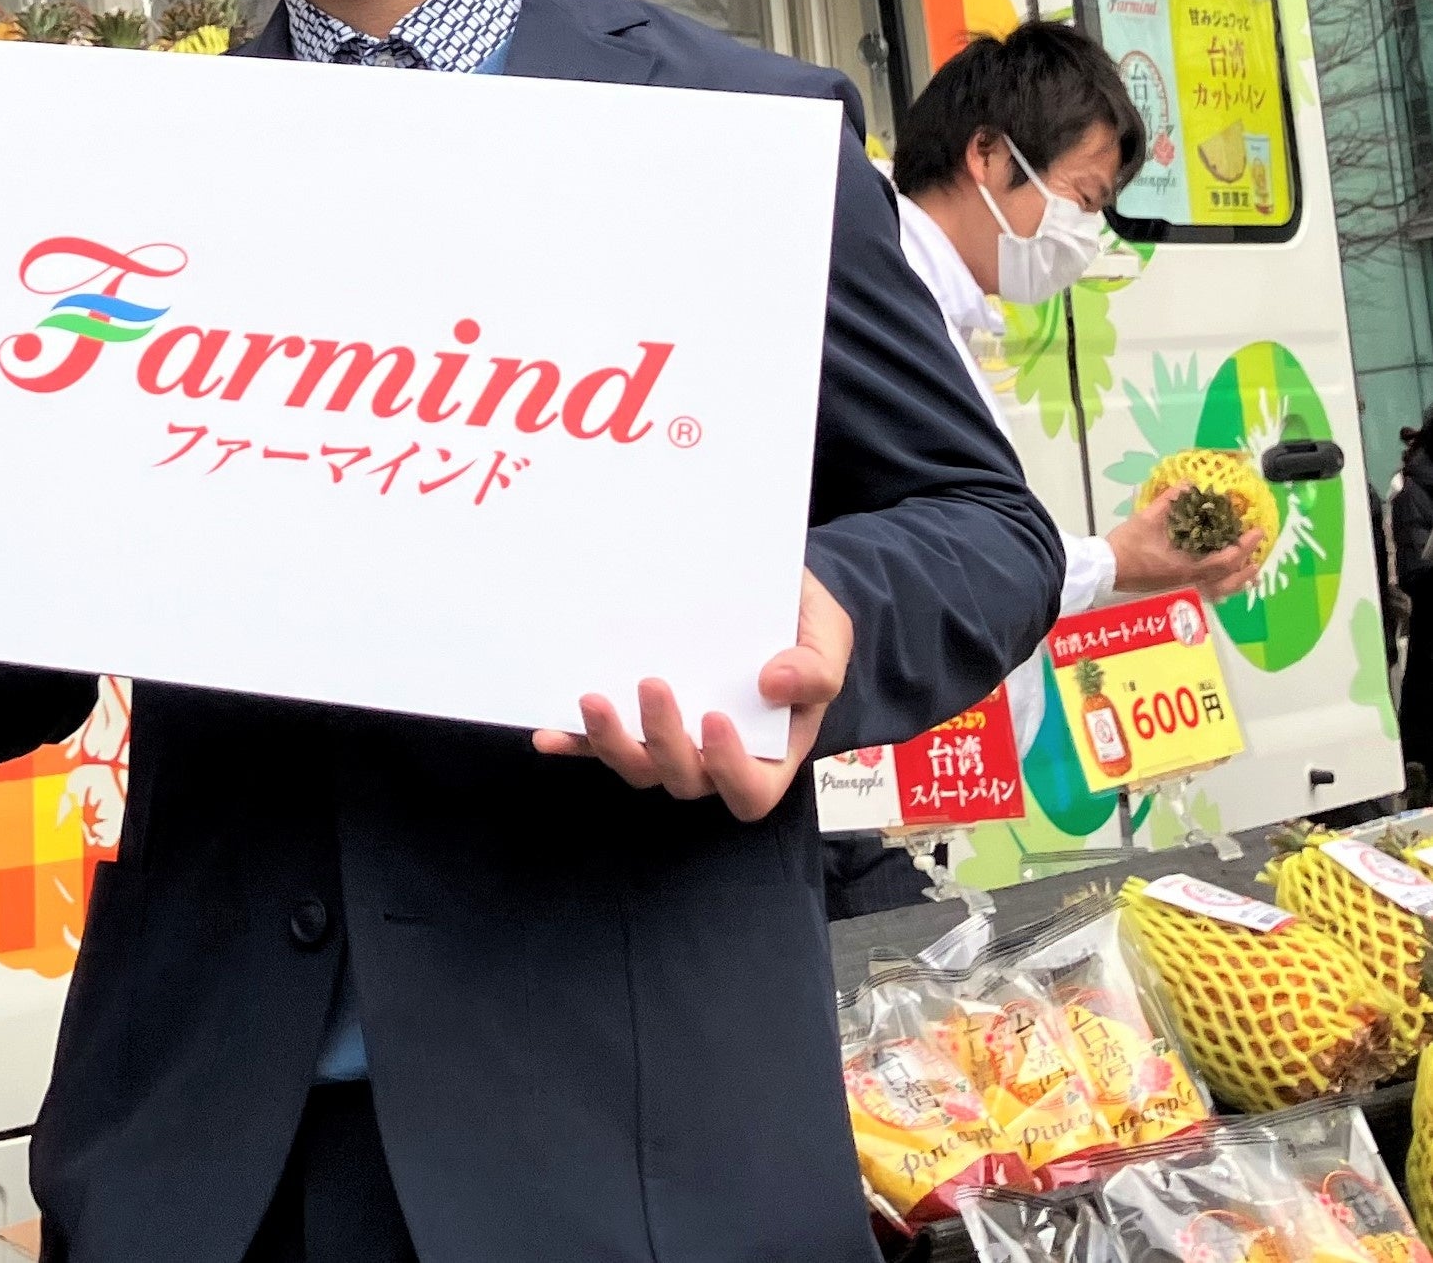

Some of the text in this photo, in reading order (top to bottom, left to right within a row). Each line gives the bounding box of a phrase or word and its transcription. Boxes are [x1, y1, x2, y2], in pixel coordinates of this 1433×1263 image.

[151, 421, 532, 507] ファーマインド
[926, 734, 985, 778] 台湾
[909, 777, 1017, 810] スイートパイン
